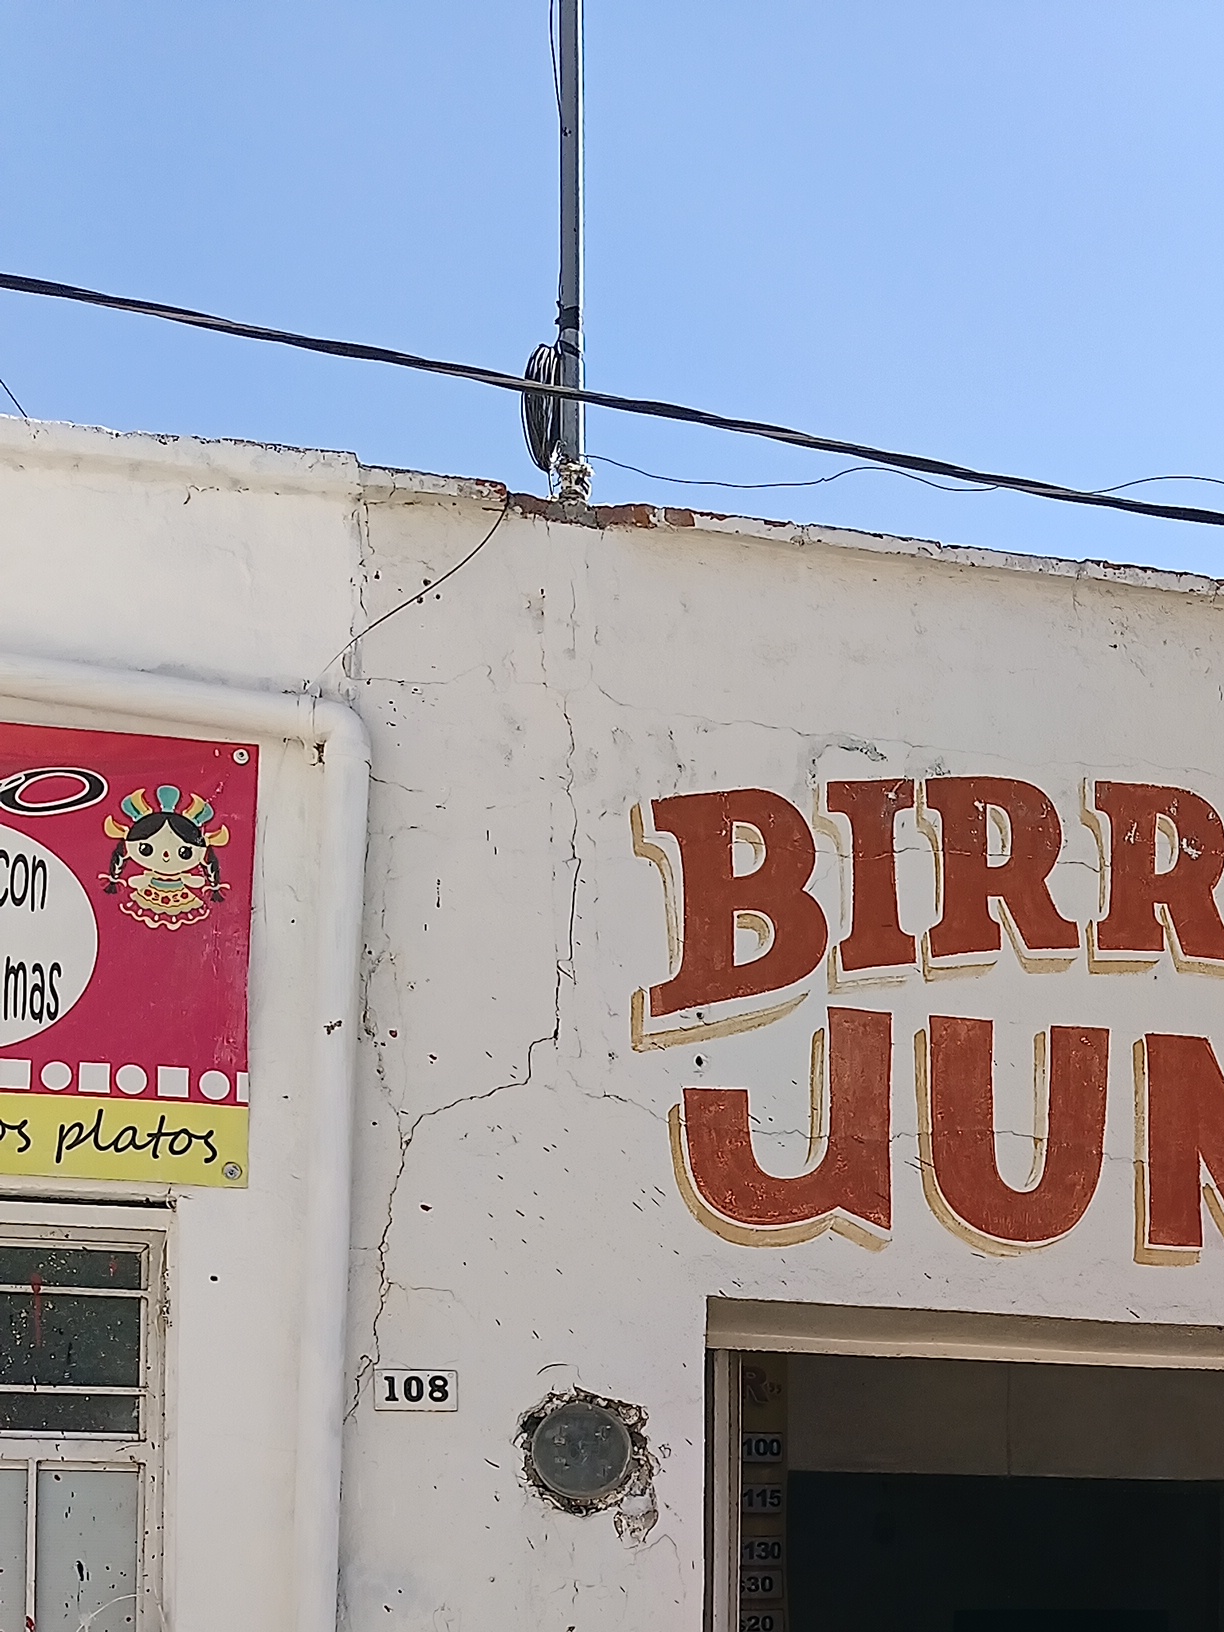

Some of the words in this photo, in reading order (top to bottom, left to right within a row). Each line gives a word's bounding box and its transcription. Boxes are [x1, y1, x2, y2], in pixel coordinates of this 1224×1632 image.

[0, 1118, 32, 1154] s
[54, 1107, 220, 1164] platos
[383, 1375, 449, 1402] 108
